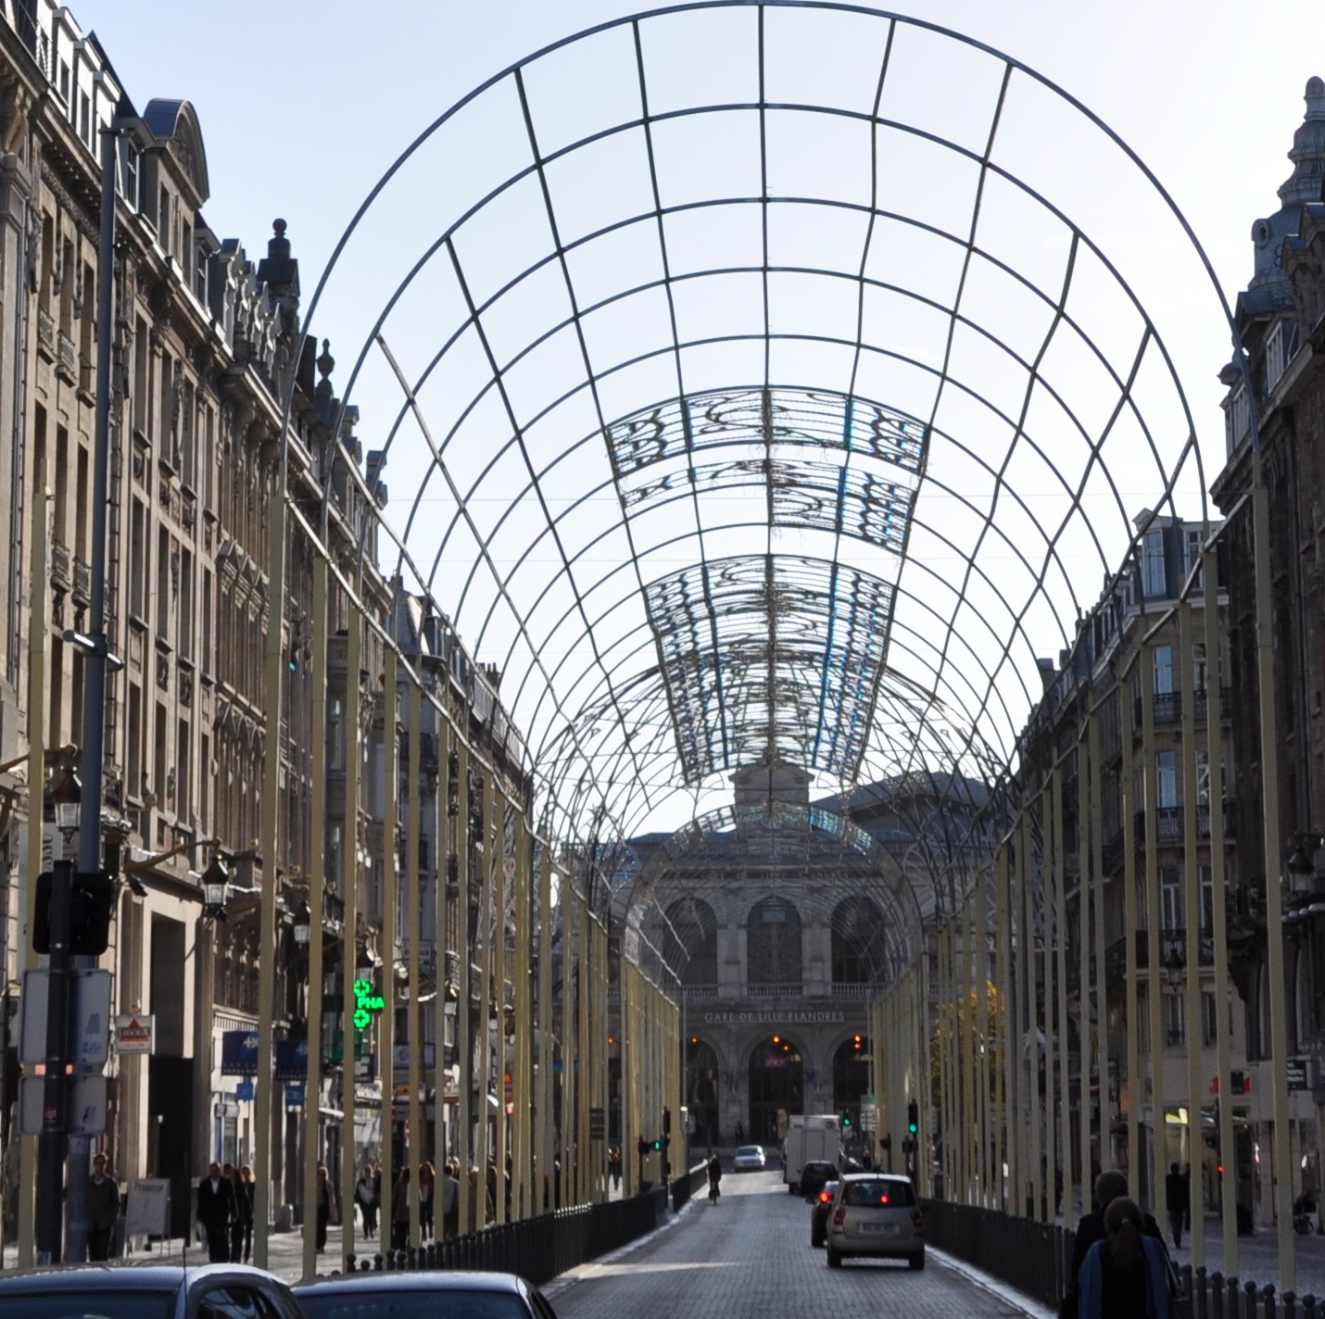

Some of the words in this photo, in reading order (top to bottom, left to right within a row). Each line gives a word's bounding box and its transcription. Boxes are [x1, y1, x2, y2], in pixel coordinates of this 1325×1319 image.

[358, 996, 384, 1009] PHA
[739, 1012, 752, 1022] DE
[759, 1012, 783, 1022] LILLE
[788, 1012, 845, 1022] FLANDRES
